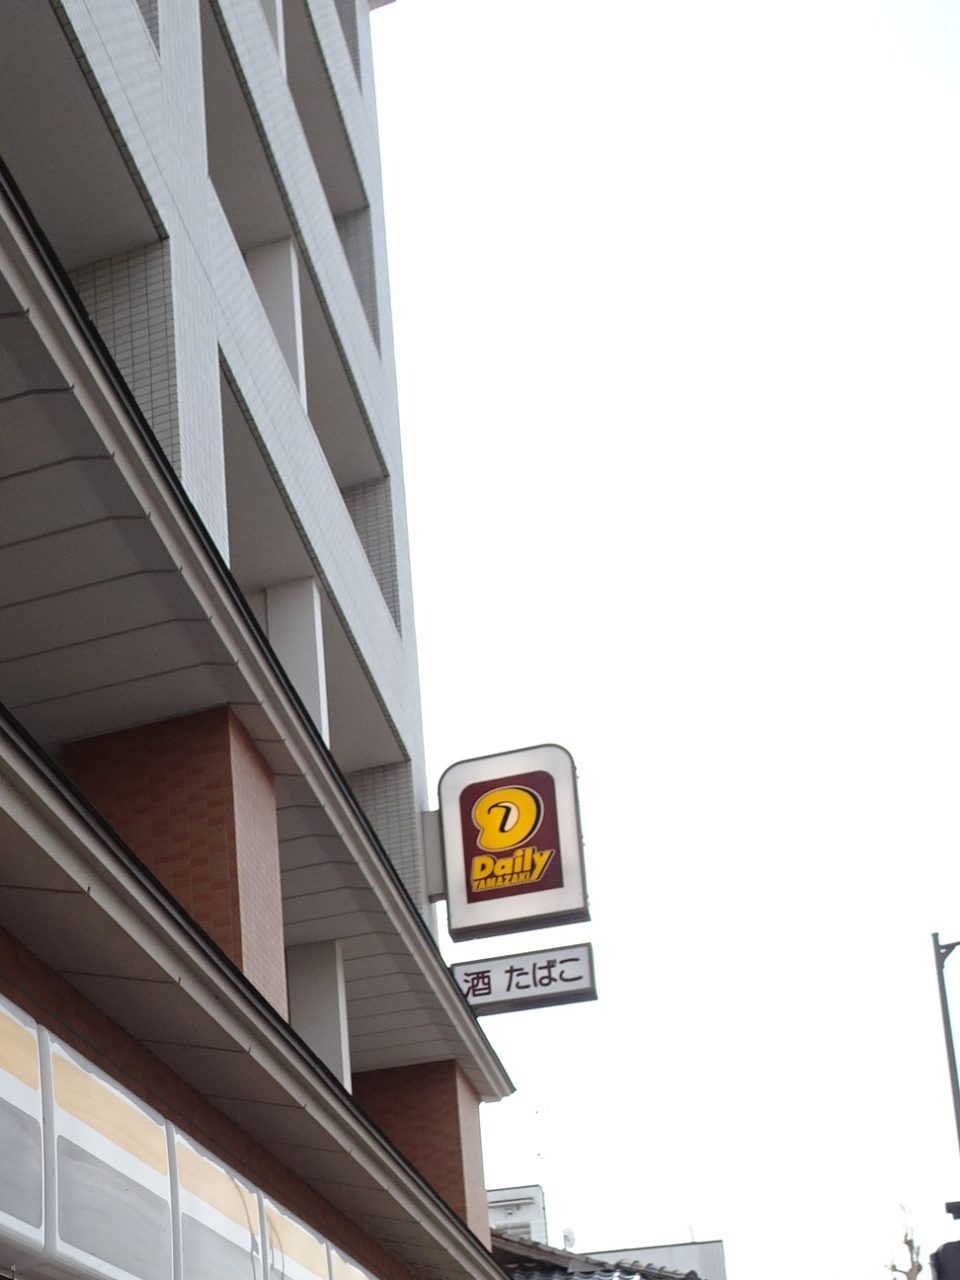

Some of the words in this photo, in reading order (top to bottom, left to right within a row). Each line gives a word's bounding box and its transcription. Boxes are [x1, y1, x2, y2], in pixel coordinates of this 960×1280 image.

[472, 848, 554, 881] Daily
[472, 870, 532, 892] YAMAZAKI
[462, 970, 491, 997] 酒
[505, 958, 583, 992] たばこ
